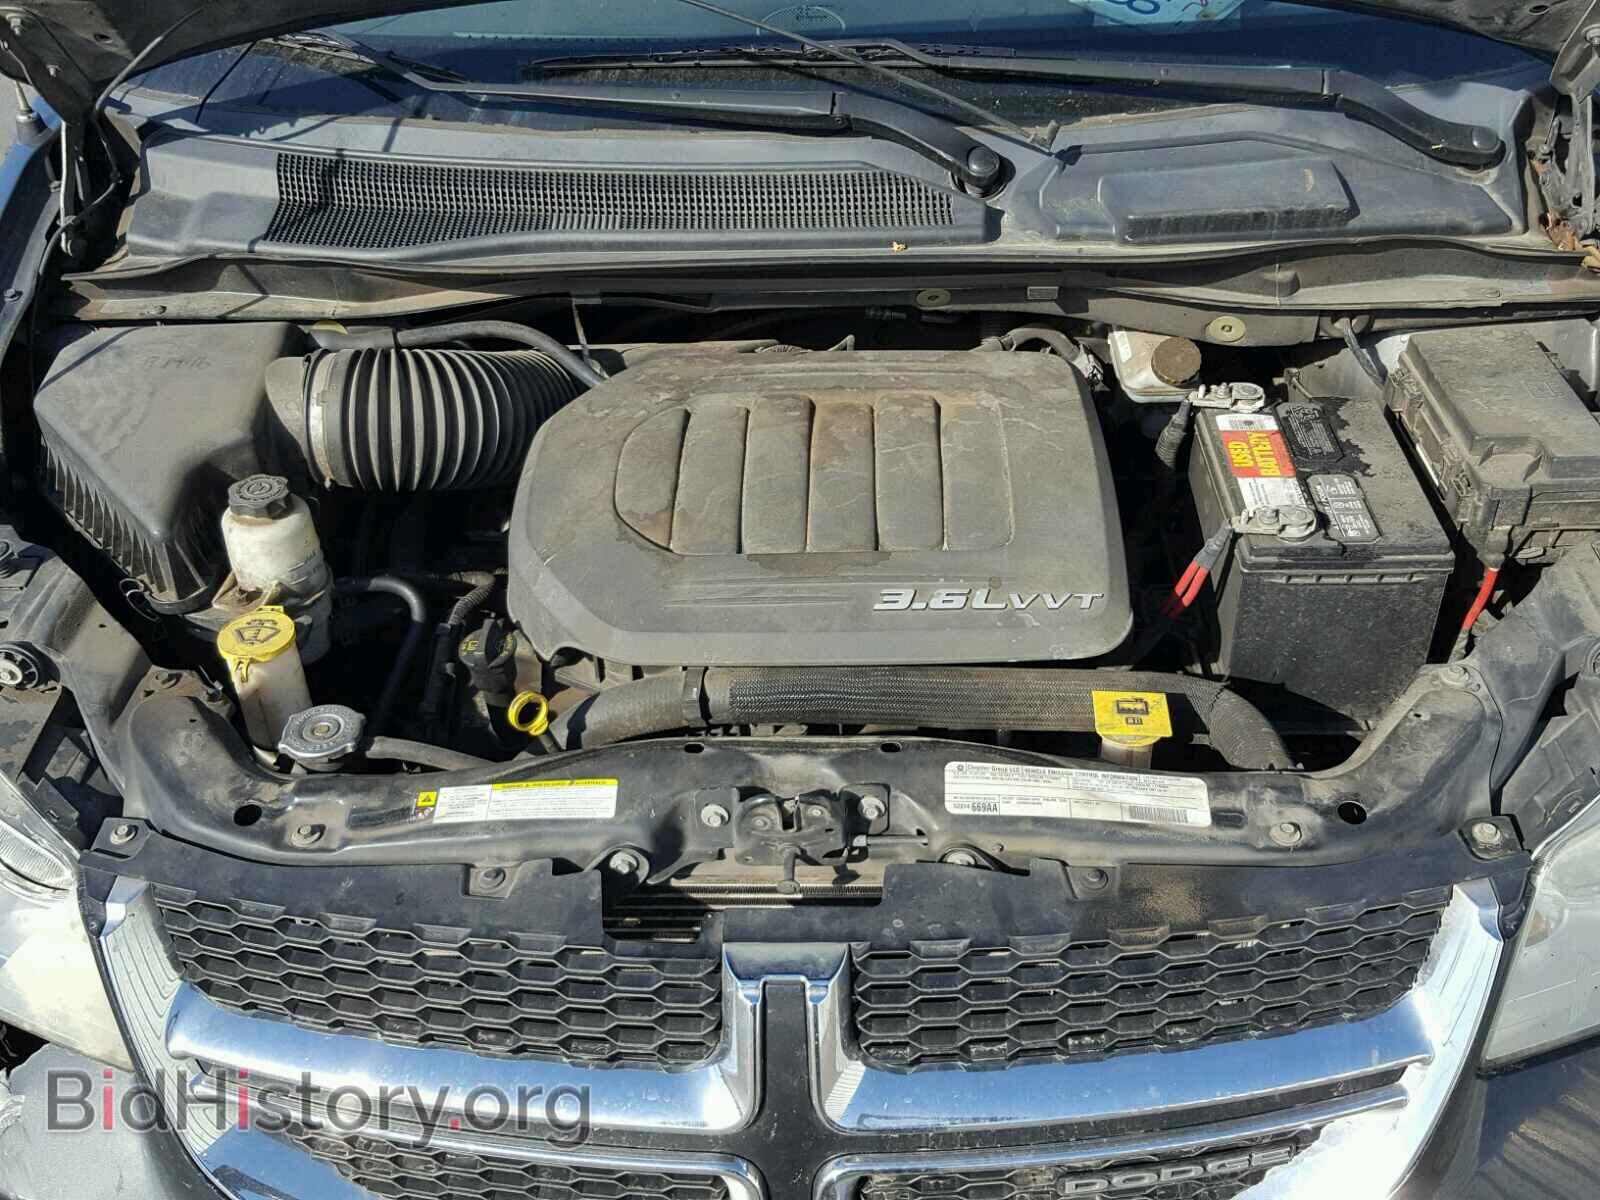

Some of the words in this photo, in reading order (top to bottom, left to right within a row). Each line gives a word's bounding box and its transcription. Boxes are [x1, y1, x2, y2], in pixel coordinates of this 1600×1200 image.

[1228, 441, 1254, 468] USED
[1248, 432, 1280, 477] BATTERY
[971, 803, 998, 813] 669AA
[1064, 1147, 1293, 1194] DODGE
